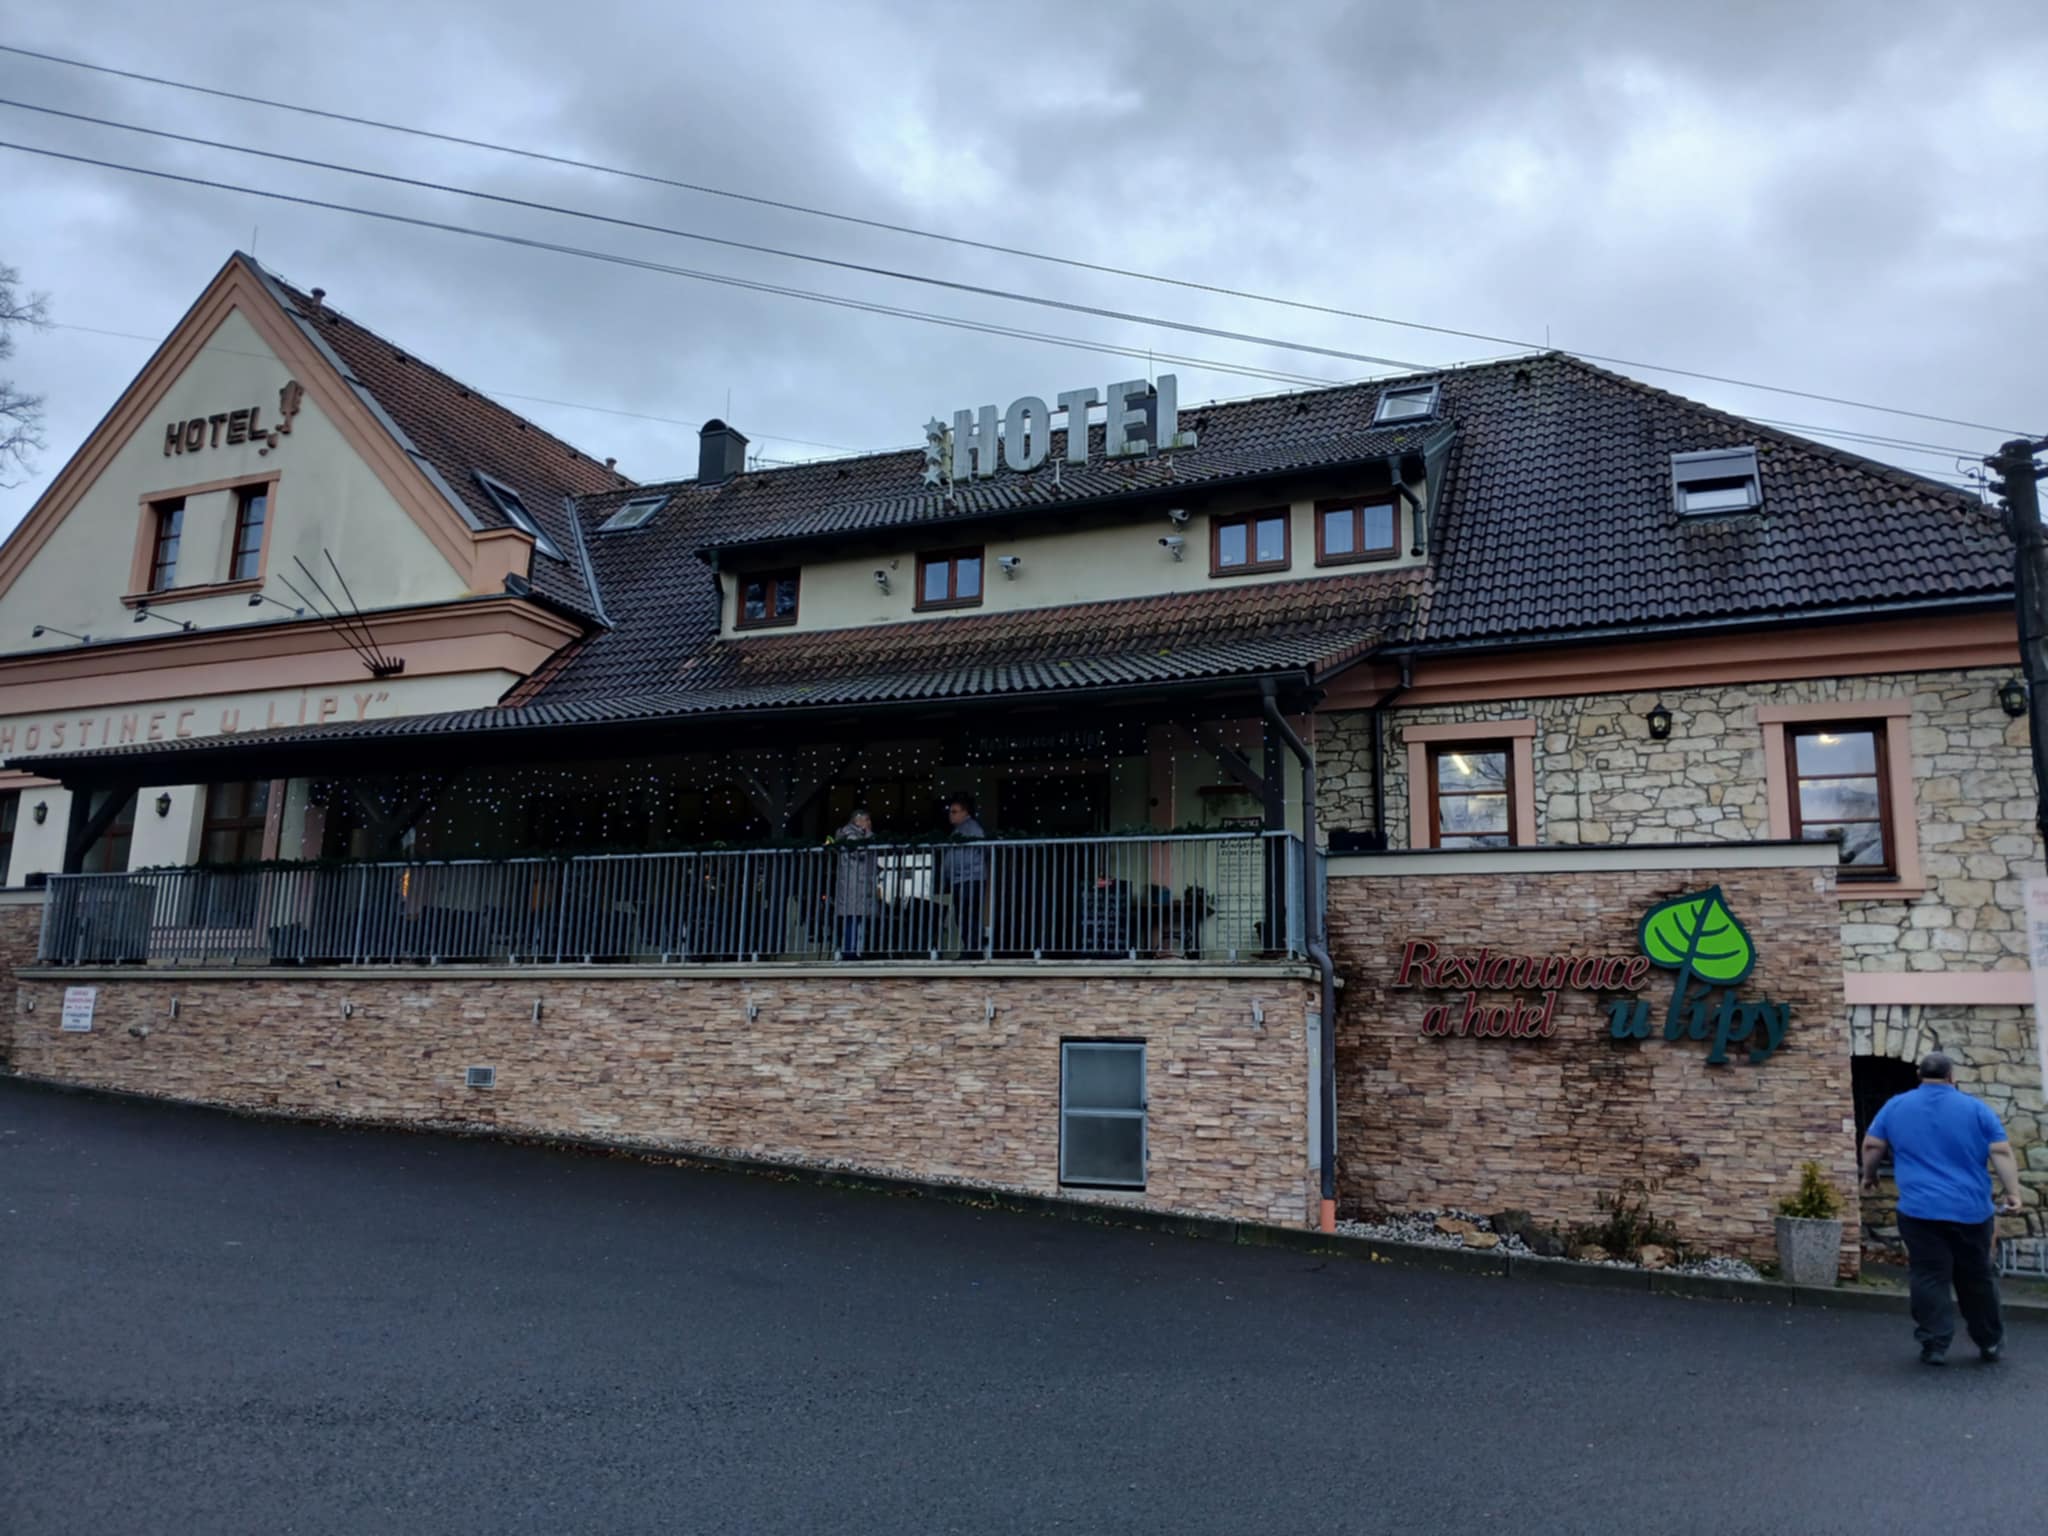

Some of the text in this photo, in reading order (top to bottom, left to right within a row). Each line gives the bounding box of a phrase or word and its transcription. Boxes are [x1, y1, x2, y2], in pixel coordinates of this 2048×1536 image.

[163, 406, 268, 457] HOTEL
[952, 374, 1197, 483] HOTEL
[0, 708, 196, 753] HOSTINEC
[1392, 939, 1651, 991] Restaurace
[1421, 990, 1557, 1038] a hotel
[1608, 968, 1791, 1064] u lípy
